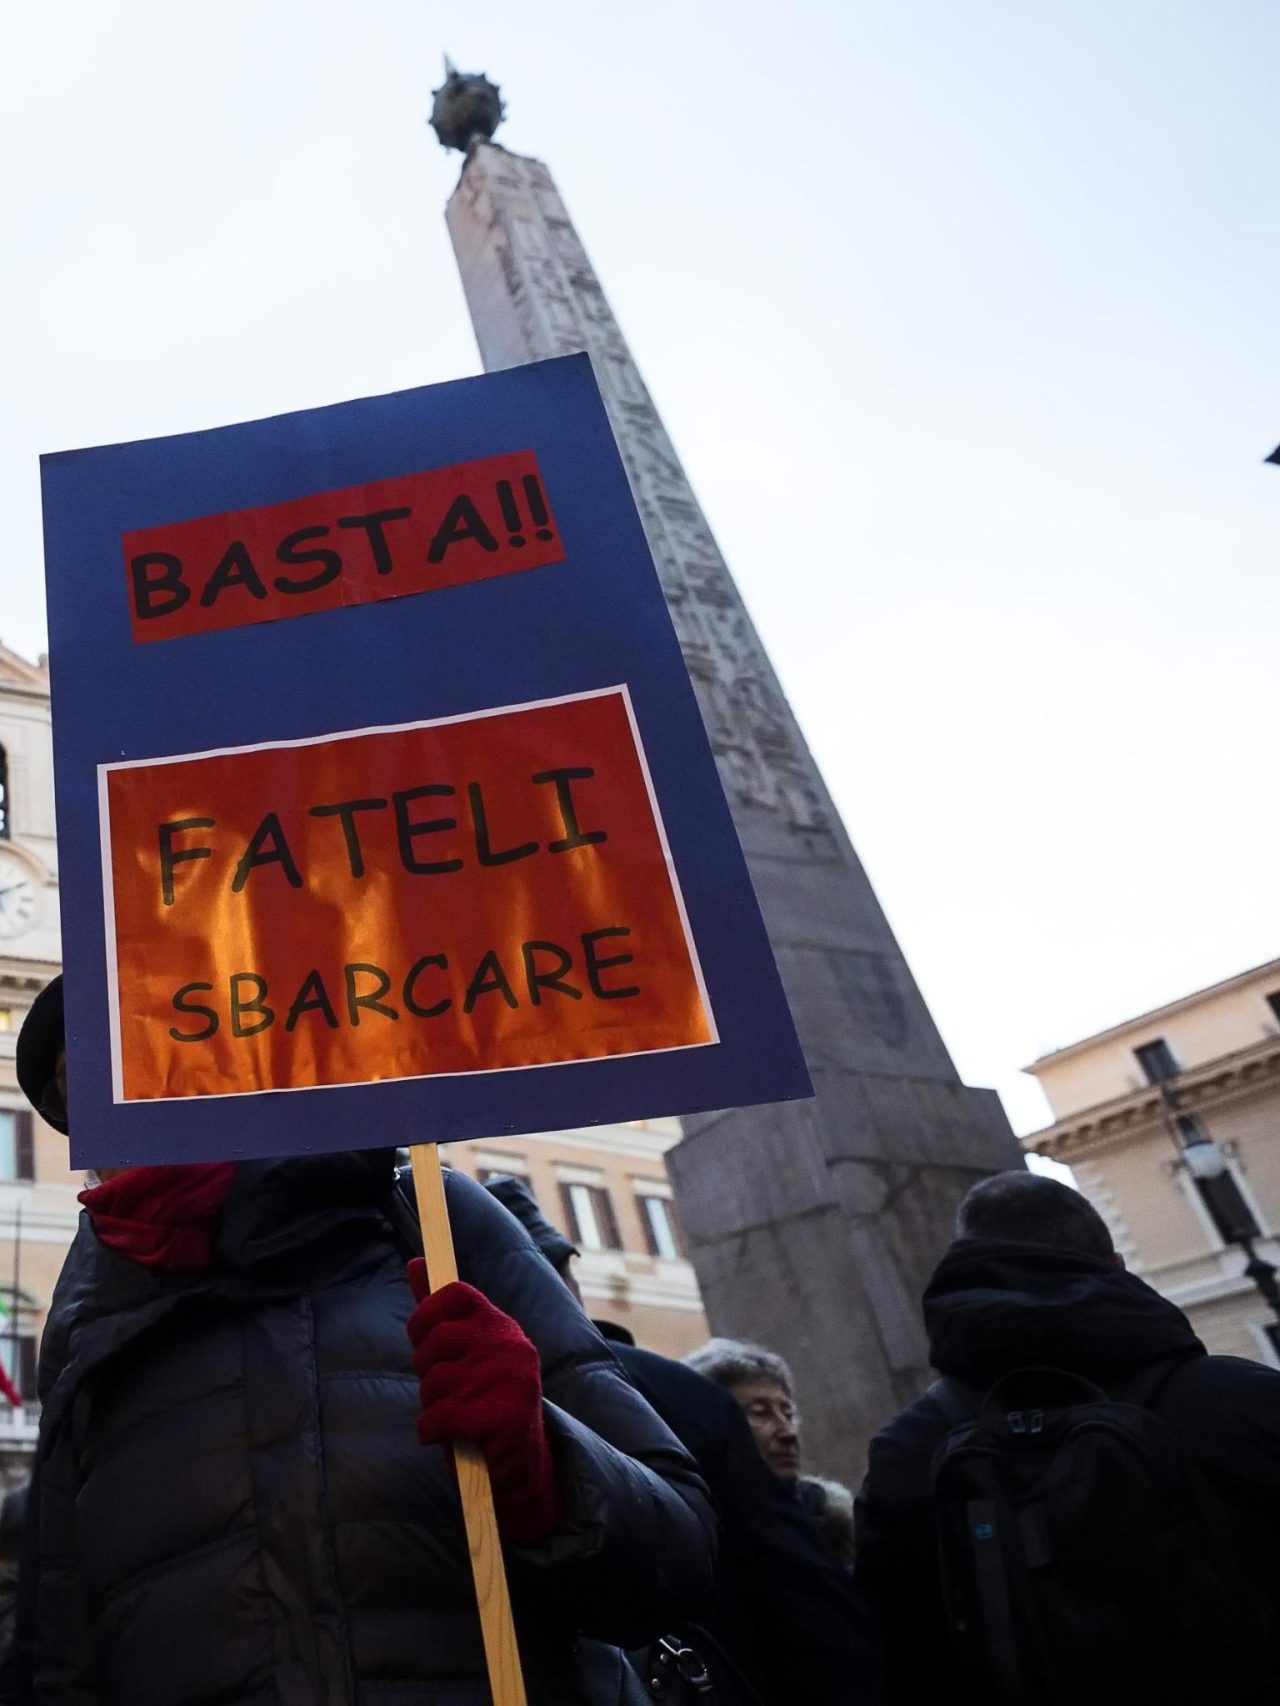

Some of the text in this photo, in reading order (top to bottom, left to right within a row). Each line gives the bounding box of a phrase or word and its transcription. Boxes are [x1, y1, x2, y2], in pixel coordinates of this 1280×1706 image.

[130, 474, 555, 620] BASTA!!
[157, 766, 607, 907] FATELI
[169, 926, 640, 1043] SBARCARE
